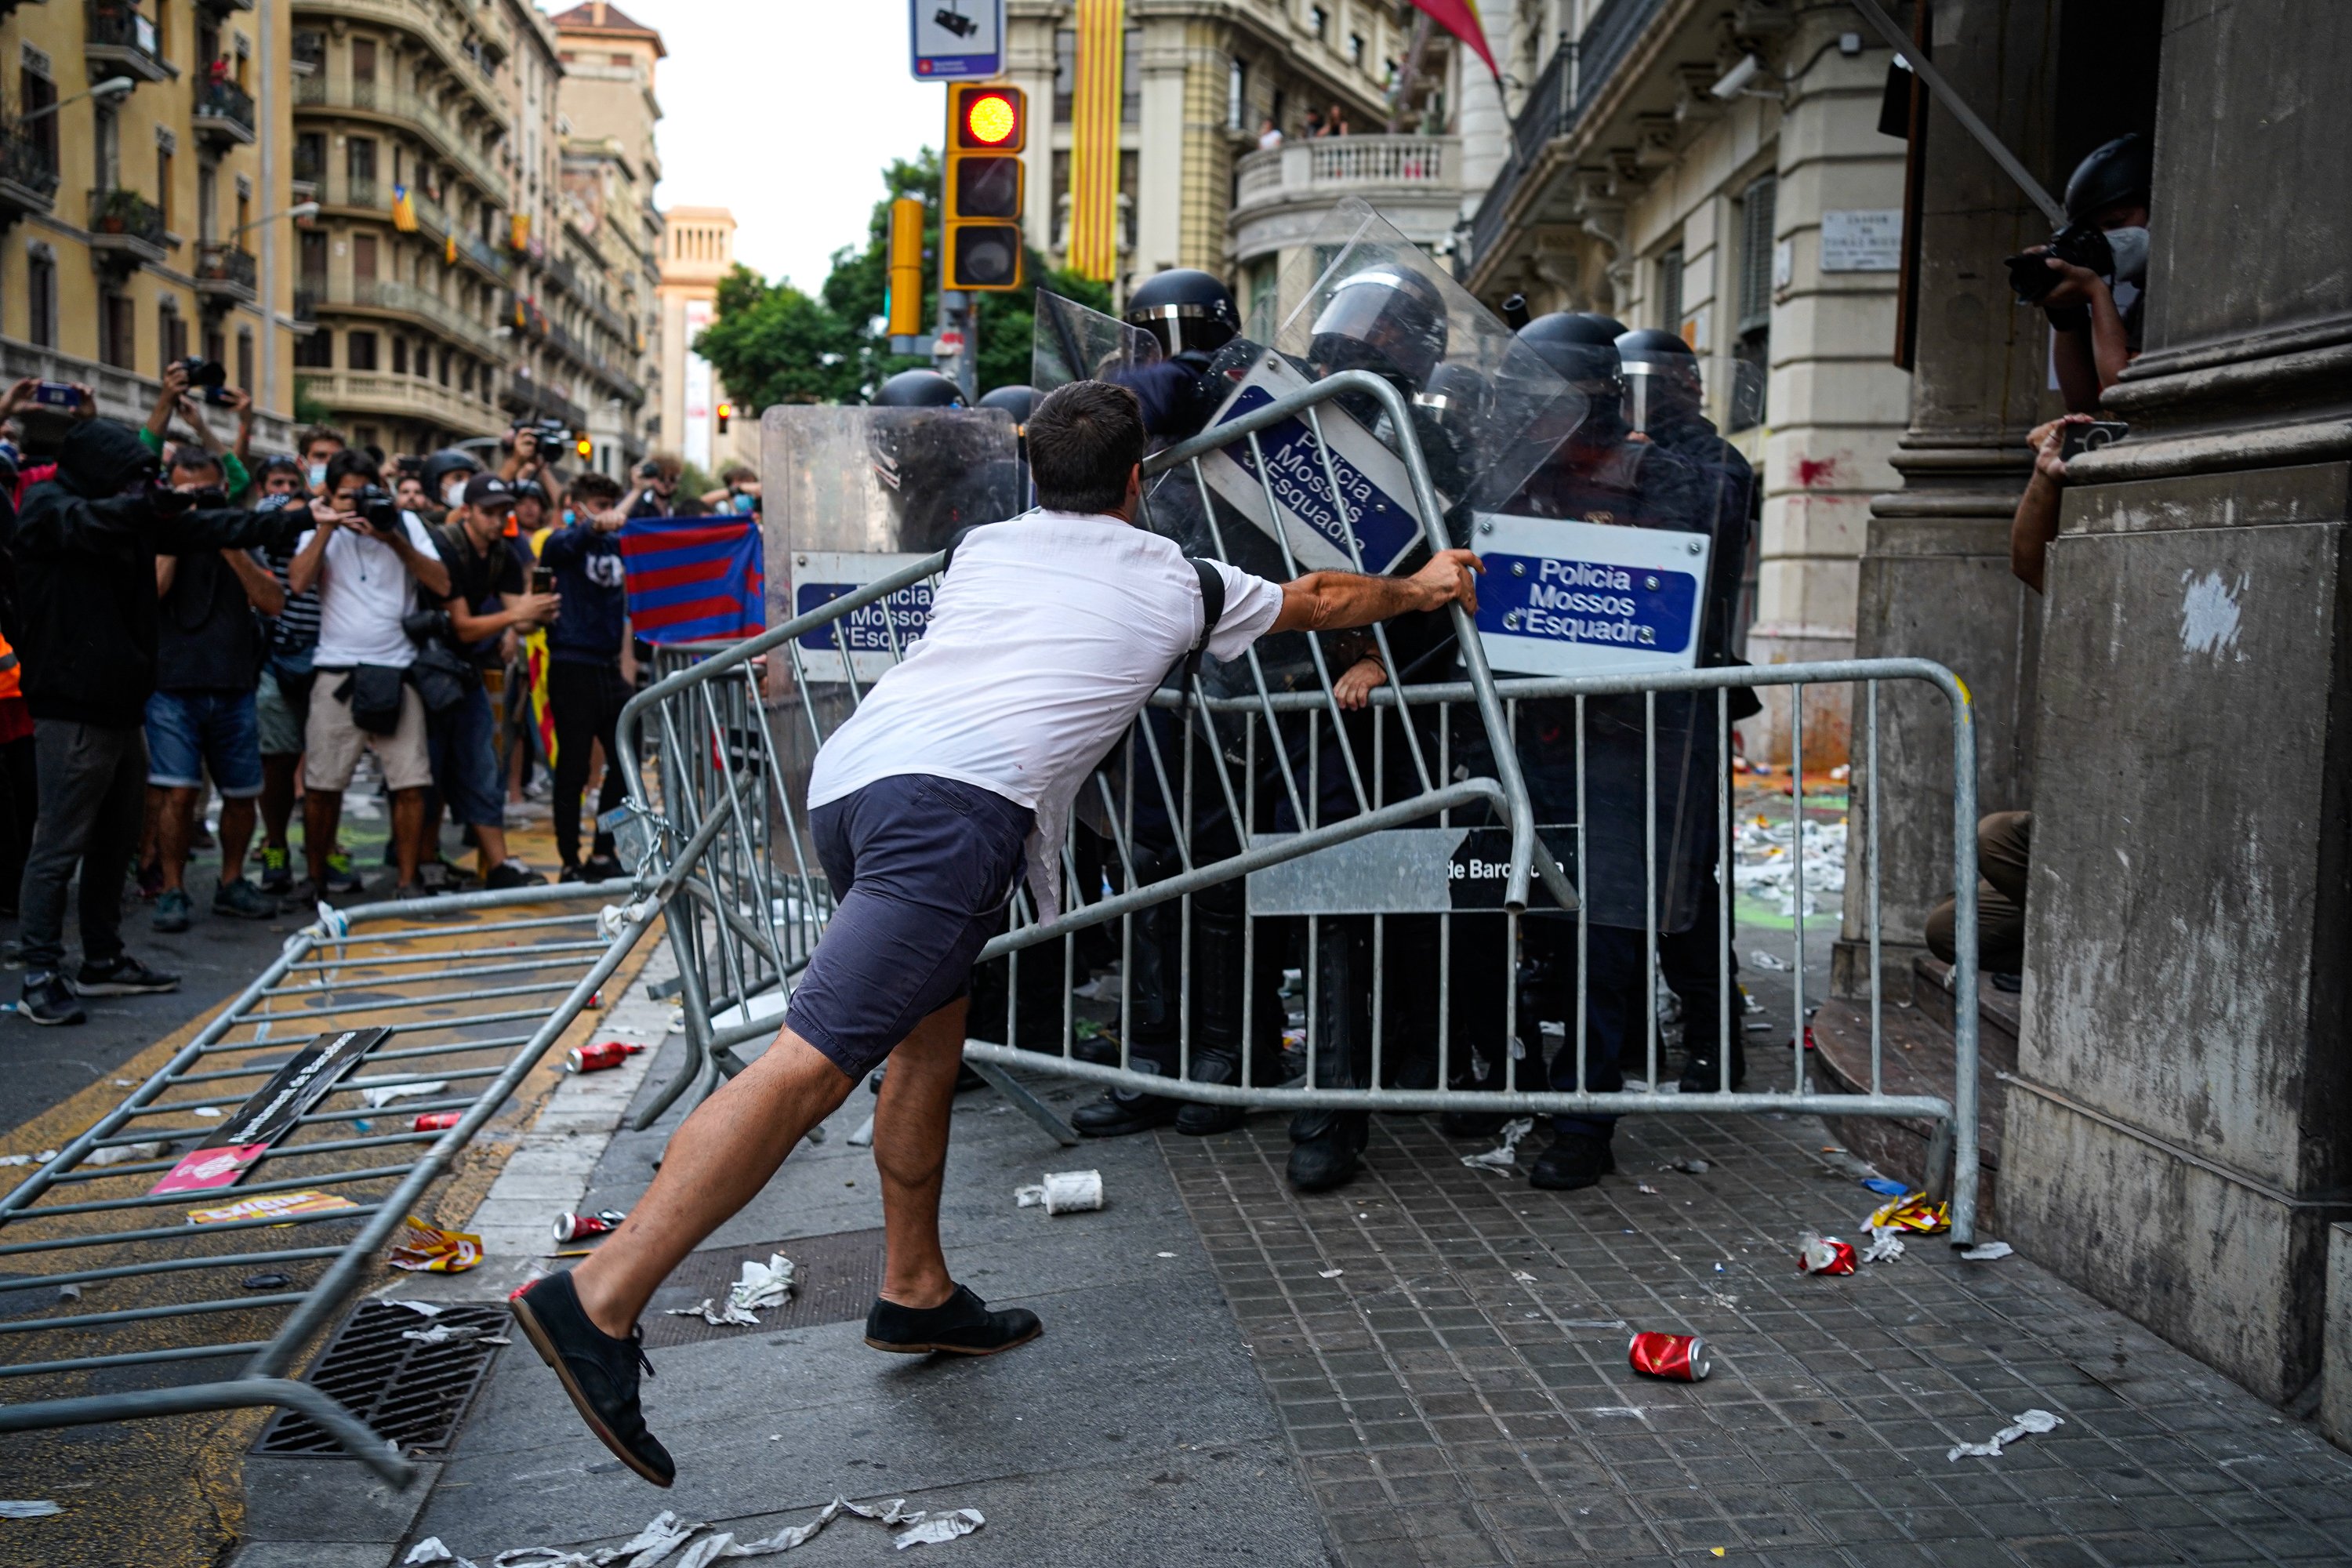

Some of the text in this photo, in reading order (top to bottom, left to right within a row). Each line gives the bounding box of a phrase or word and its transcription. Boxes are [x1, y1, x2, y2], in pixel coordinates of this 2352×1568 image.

[1294, 430, 1372, 503] Policia
[1540, 557, 1632, 591] Policia
[1530, 583, 1635, 617] Mossos
